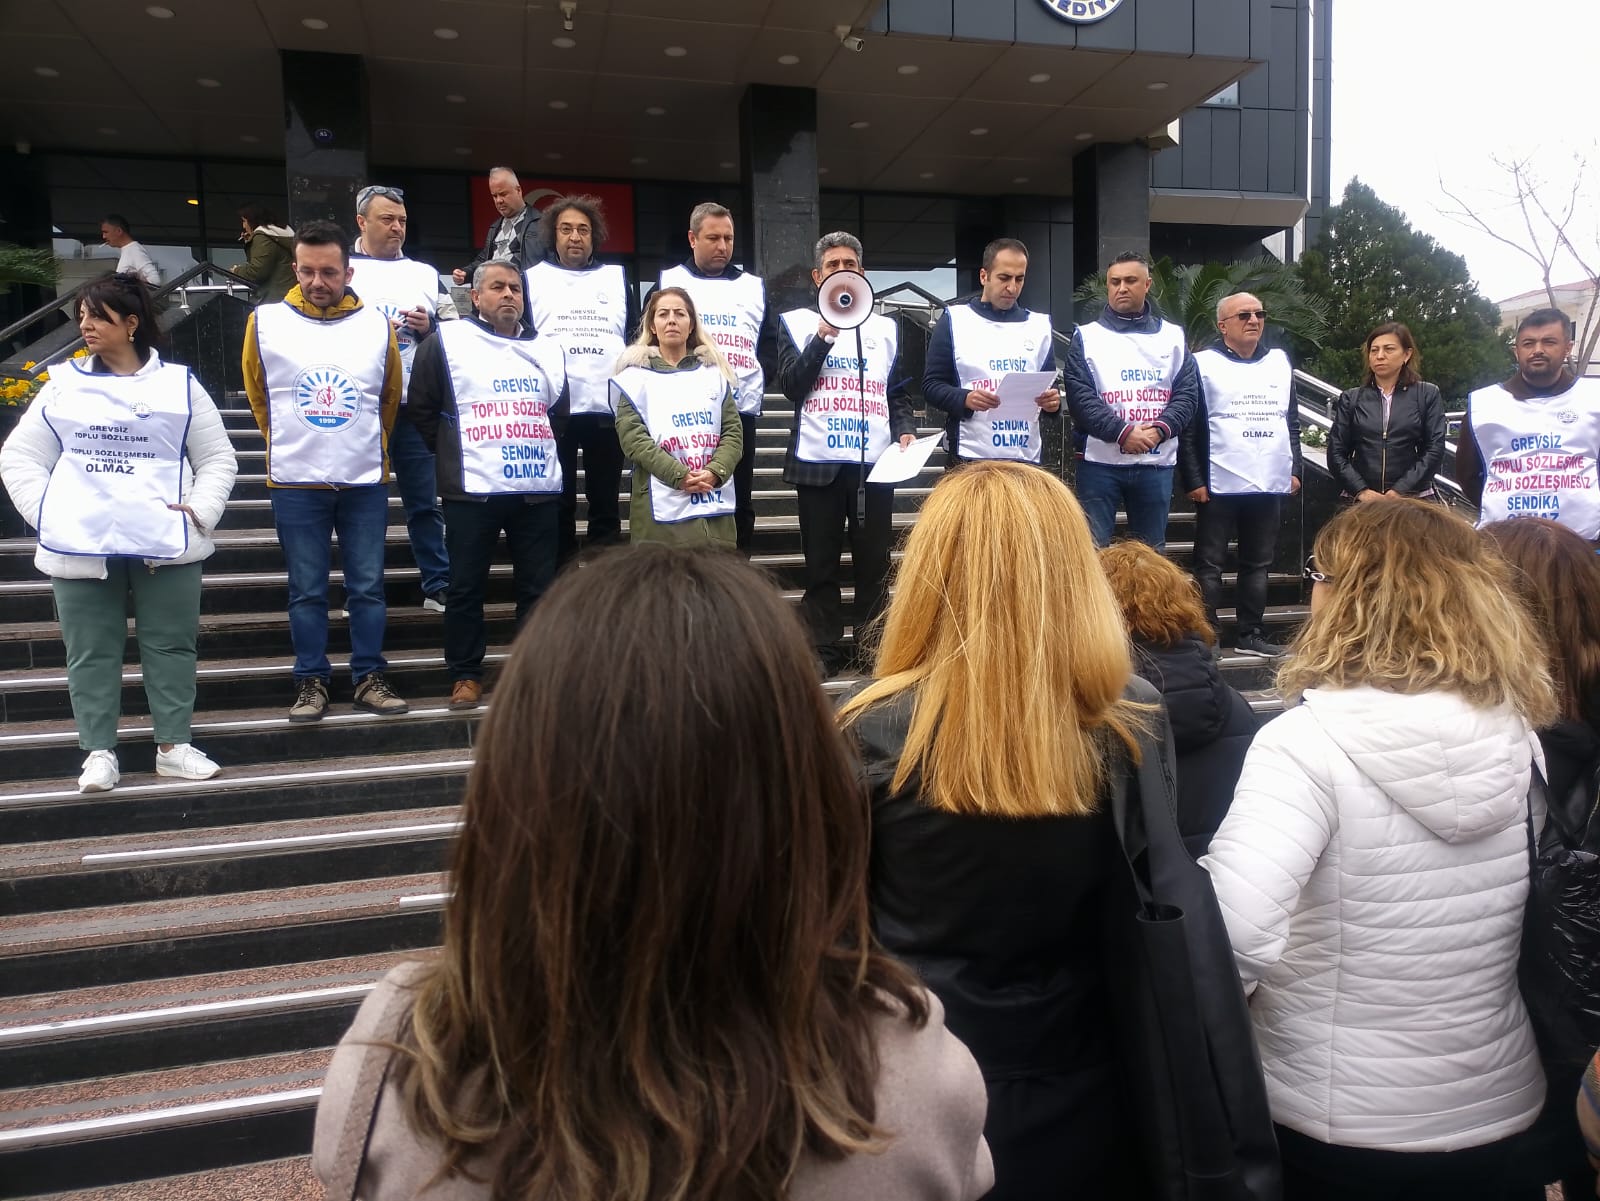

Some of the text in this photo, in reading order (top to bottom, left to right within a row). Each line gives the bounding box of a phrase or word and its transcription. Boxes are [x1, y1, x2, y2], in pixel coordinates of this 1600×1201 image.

[569, 347, 605, 355] OLMAZ
[827, 354, 869, 371] GREVSZ
[989, 356, 1027, 372] GREVSİZ
[1121, 367, 1163, 382] GREVSİZ
[493, 375, 541, 393] GREVSİZ
[1102, 389, 1133, 405] TOPLU
[472, 402, 509, 419] TOPLU
[672, 408, 713, 428] GREVSİZ
[89, 425, 129, 433] GREVSİZ
[466, 424, 502, 442] TOPLU
[75, 432, 149, 443] TOPLU SÖZLEŞME
[827, 434, 870, 451] OLMAZ
[992, 433, 1029, 448] OLMAZ
[1511, 432, 1562, 452] GREVSİZ
[71, 448, 92, 456] TOPLU
[502, 442, 546, 460] SENDİKA
[85, 463, 135, 475] OLMAZ
[504, 463, 547, 479] OLMAZ
[1491, 459, 1522, 475] TOPLU
[1486, 478, 1512, 493] TOPLU
[1507, 493, 1560, 510] SENDİKA
